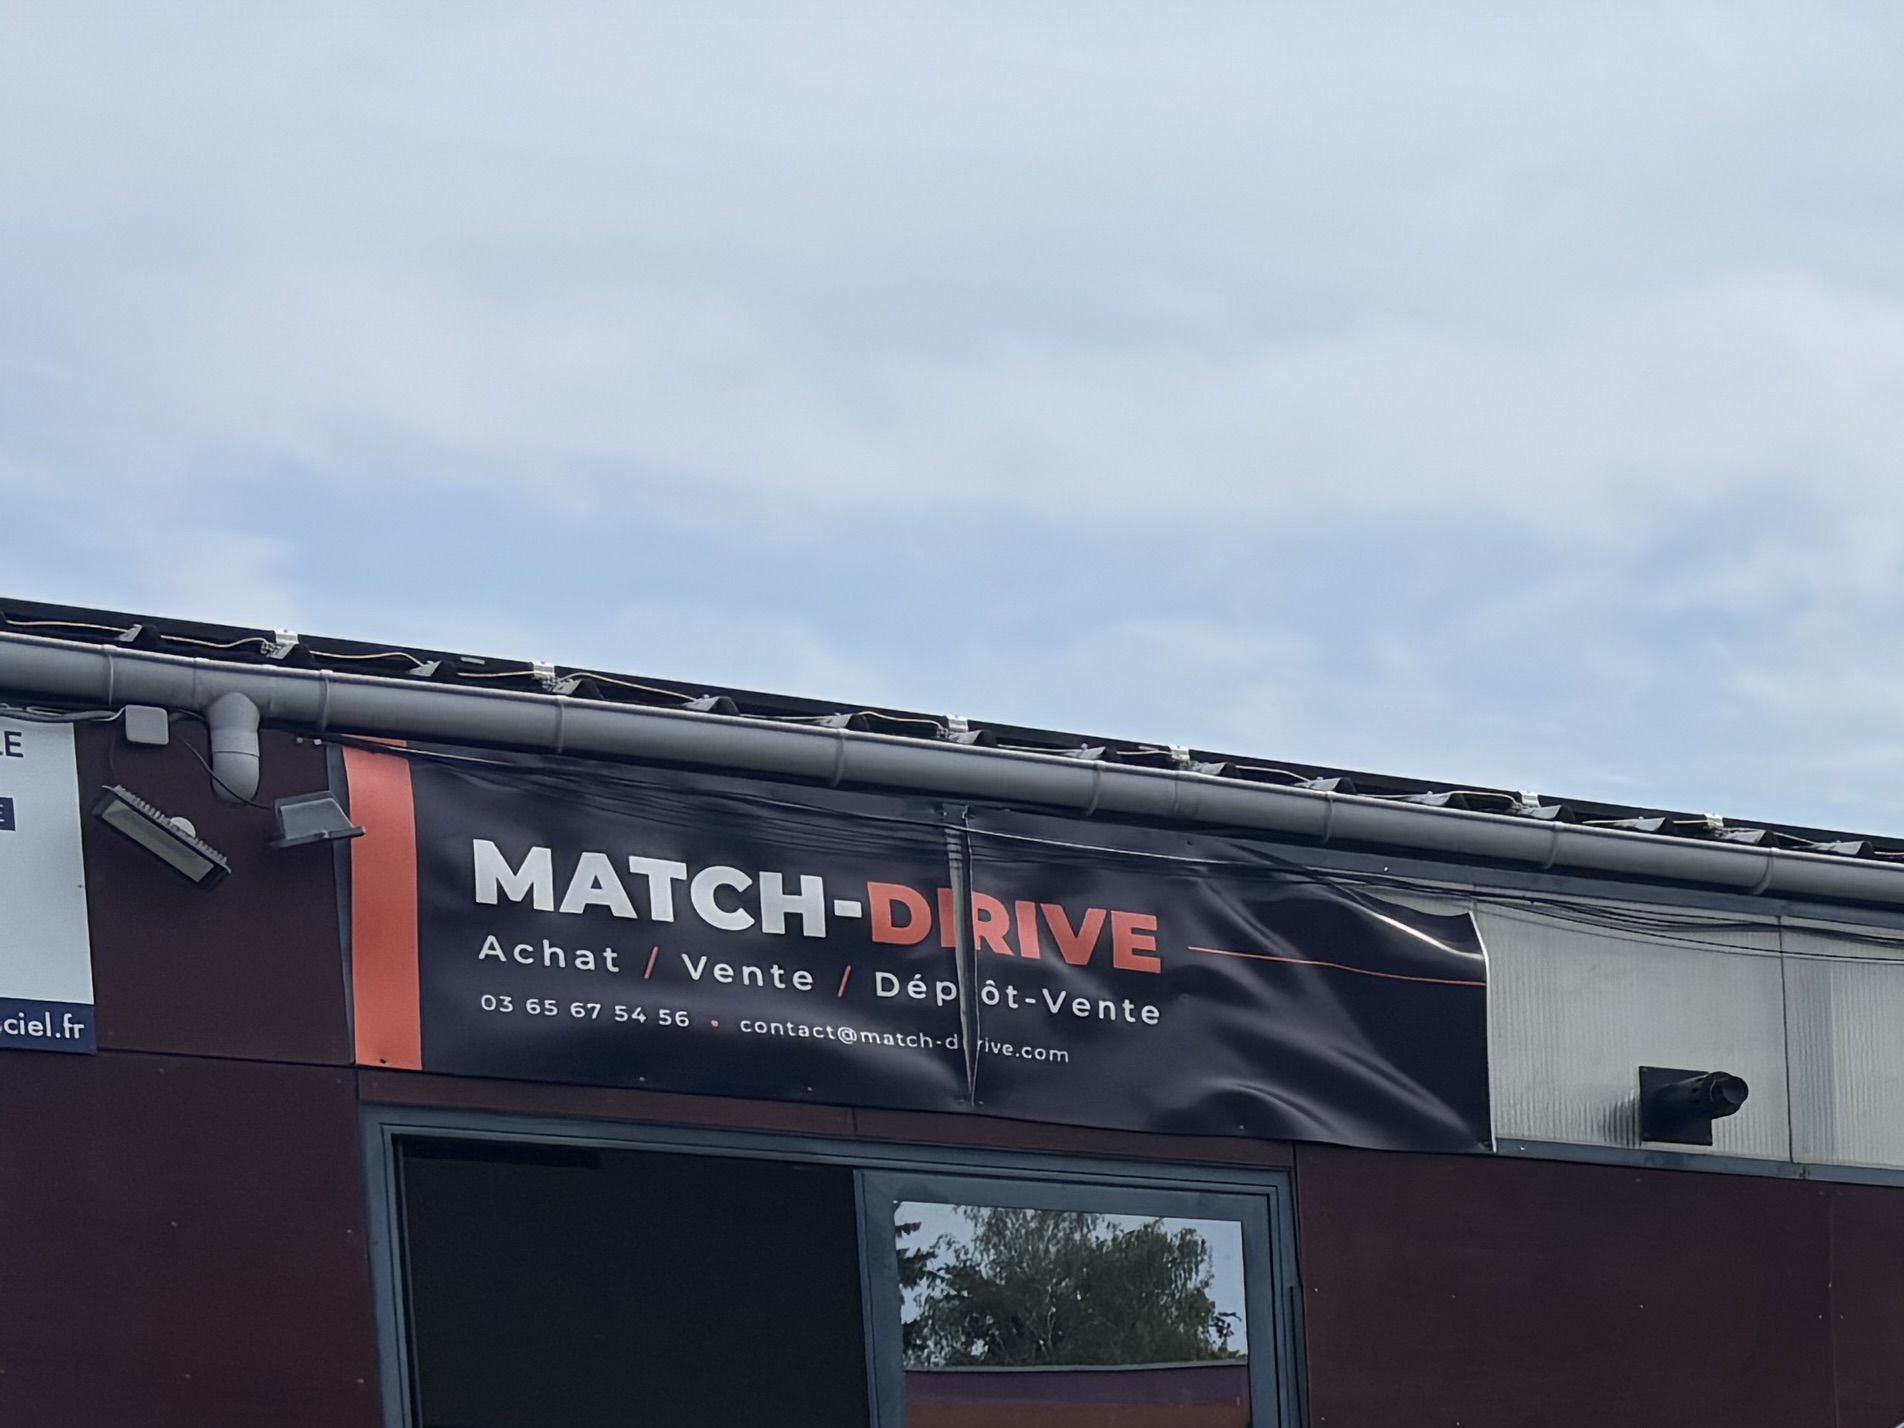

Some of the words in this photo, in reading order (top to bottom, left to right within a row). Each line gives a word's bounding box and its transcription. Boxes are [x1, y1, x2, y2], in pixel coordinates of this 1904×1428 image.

[0, 731, 24, 758] E
[473, 839, 1161, 974] MATCH-DRIVE
[478, 935, 620, 973] Achat
[682, 953, 814, 992] Vente
[875, 970, 1161, 1026] Dépôt-Vente
[0, 1011, 85, 1039] ciel.fr
[480, 994, 514, 1013] 03
[526, 998, 558, 1016] 65
[570, 1002, 602, 1020] 67
[614, 1006, 647, 1024] 54
[658, 1010, 690, 1028] 56
